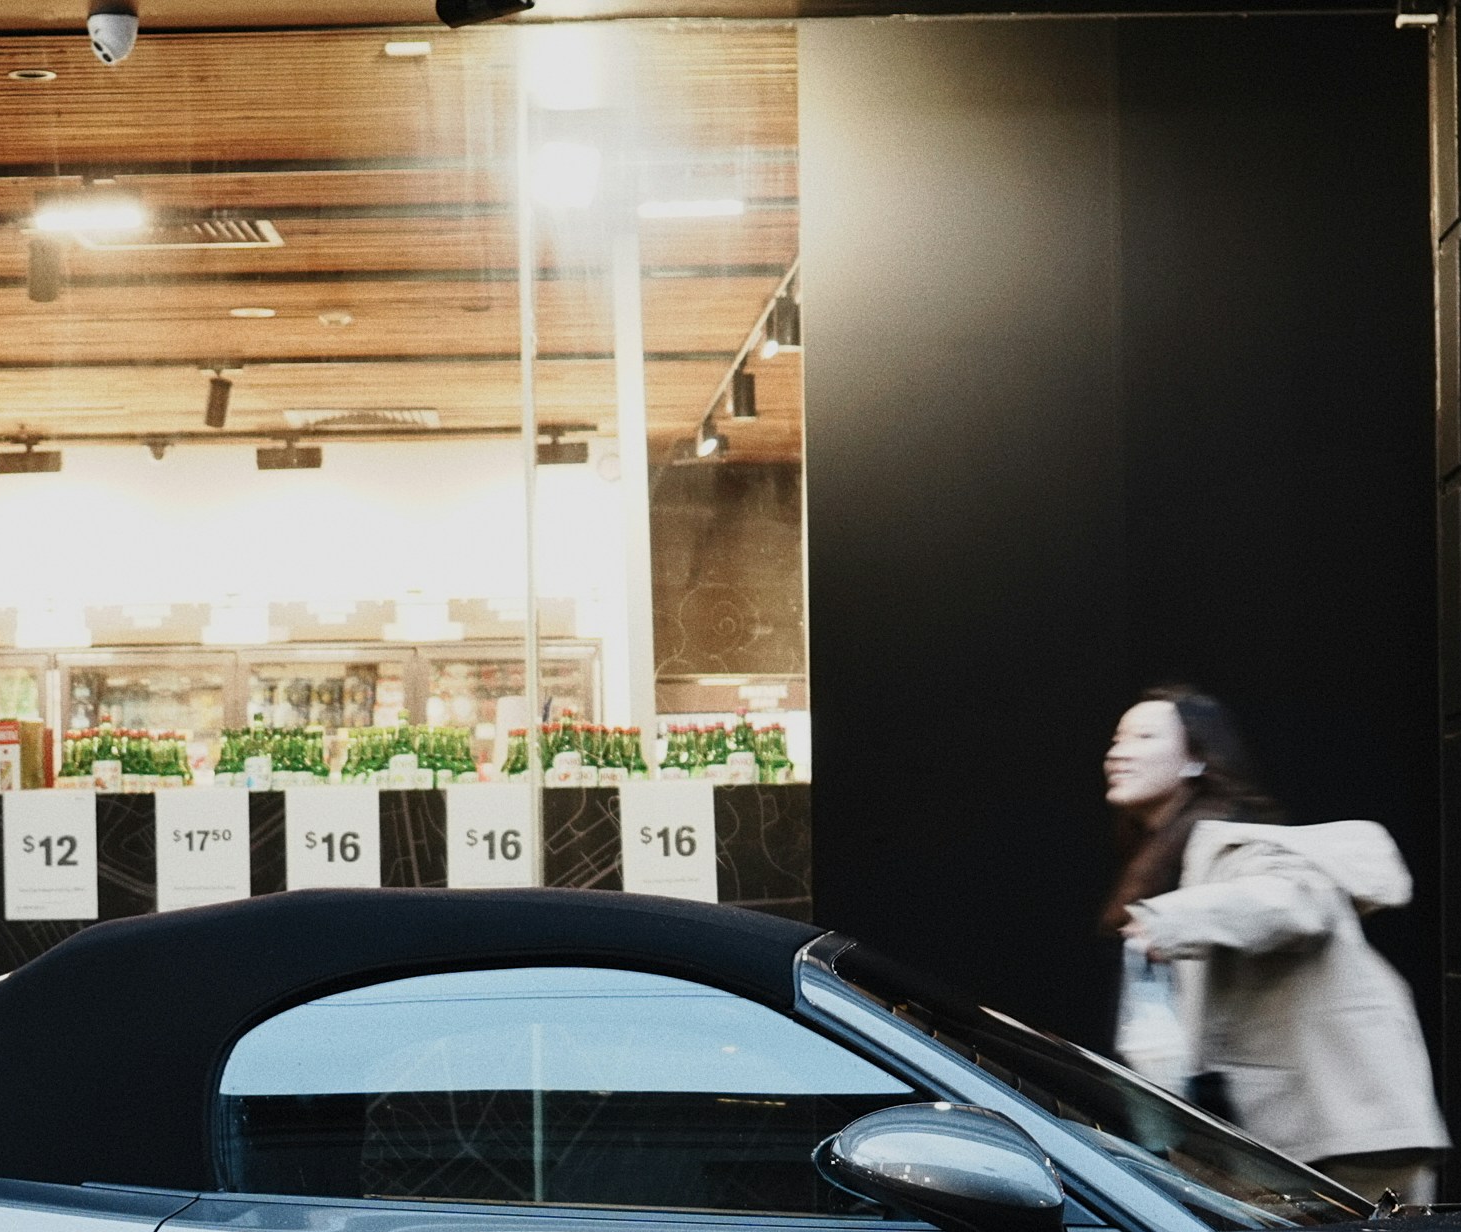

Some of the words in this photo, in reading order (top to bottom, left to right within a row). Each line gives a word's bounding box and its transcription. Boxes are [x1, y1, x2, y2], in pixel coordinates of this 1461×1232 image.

[23, 835, 79, 868] $12
[304, 831, 361, 863] $16
[465, 828, 522, 862] $16
[639, 825, 697, 858] $16
